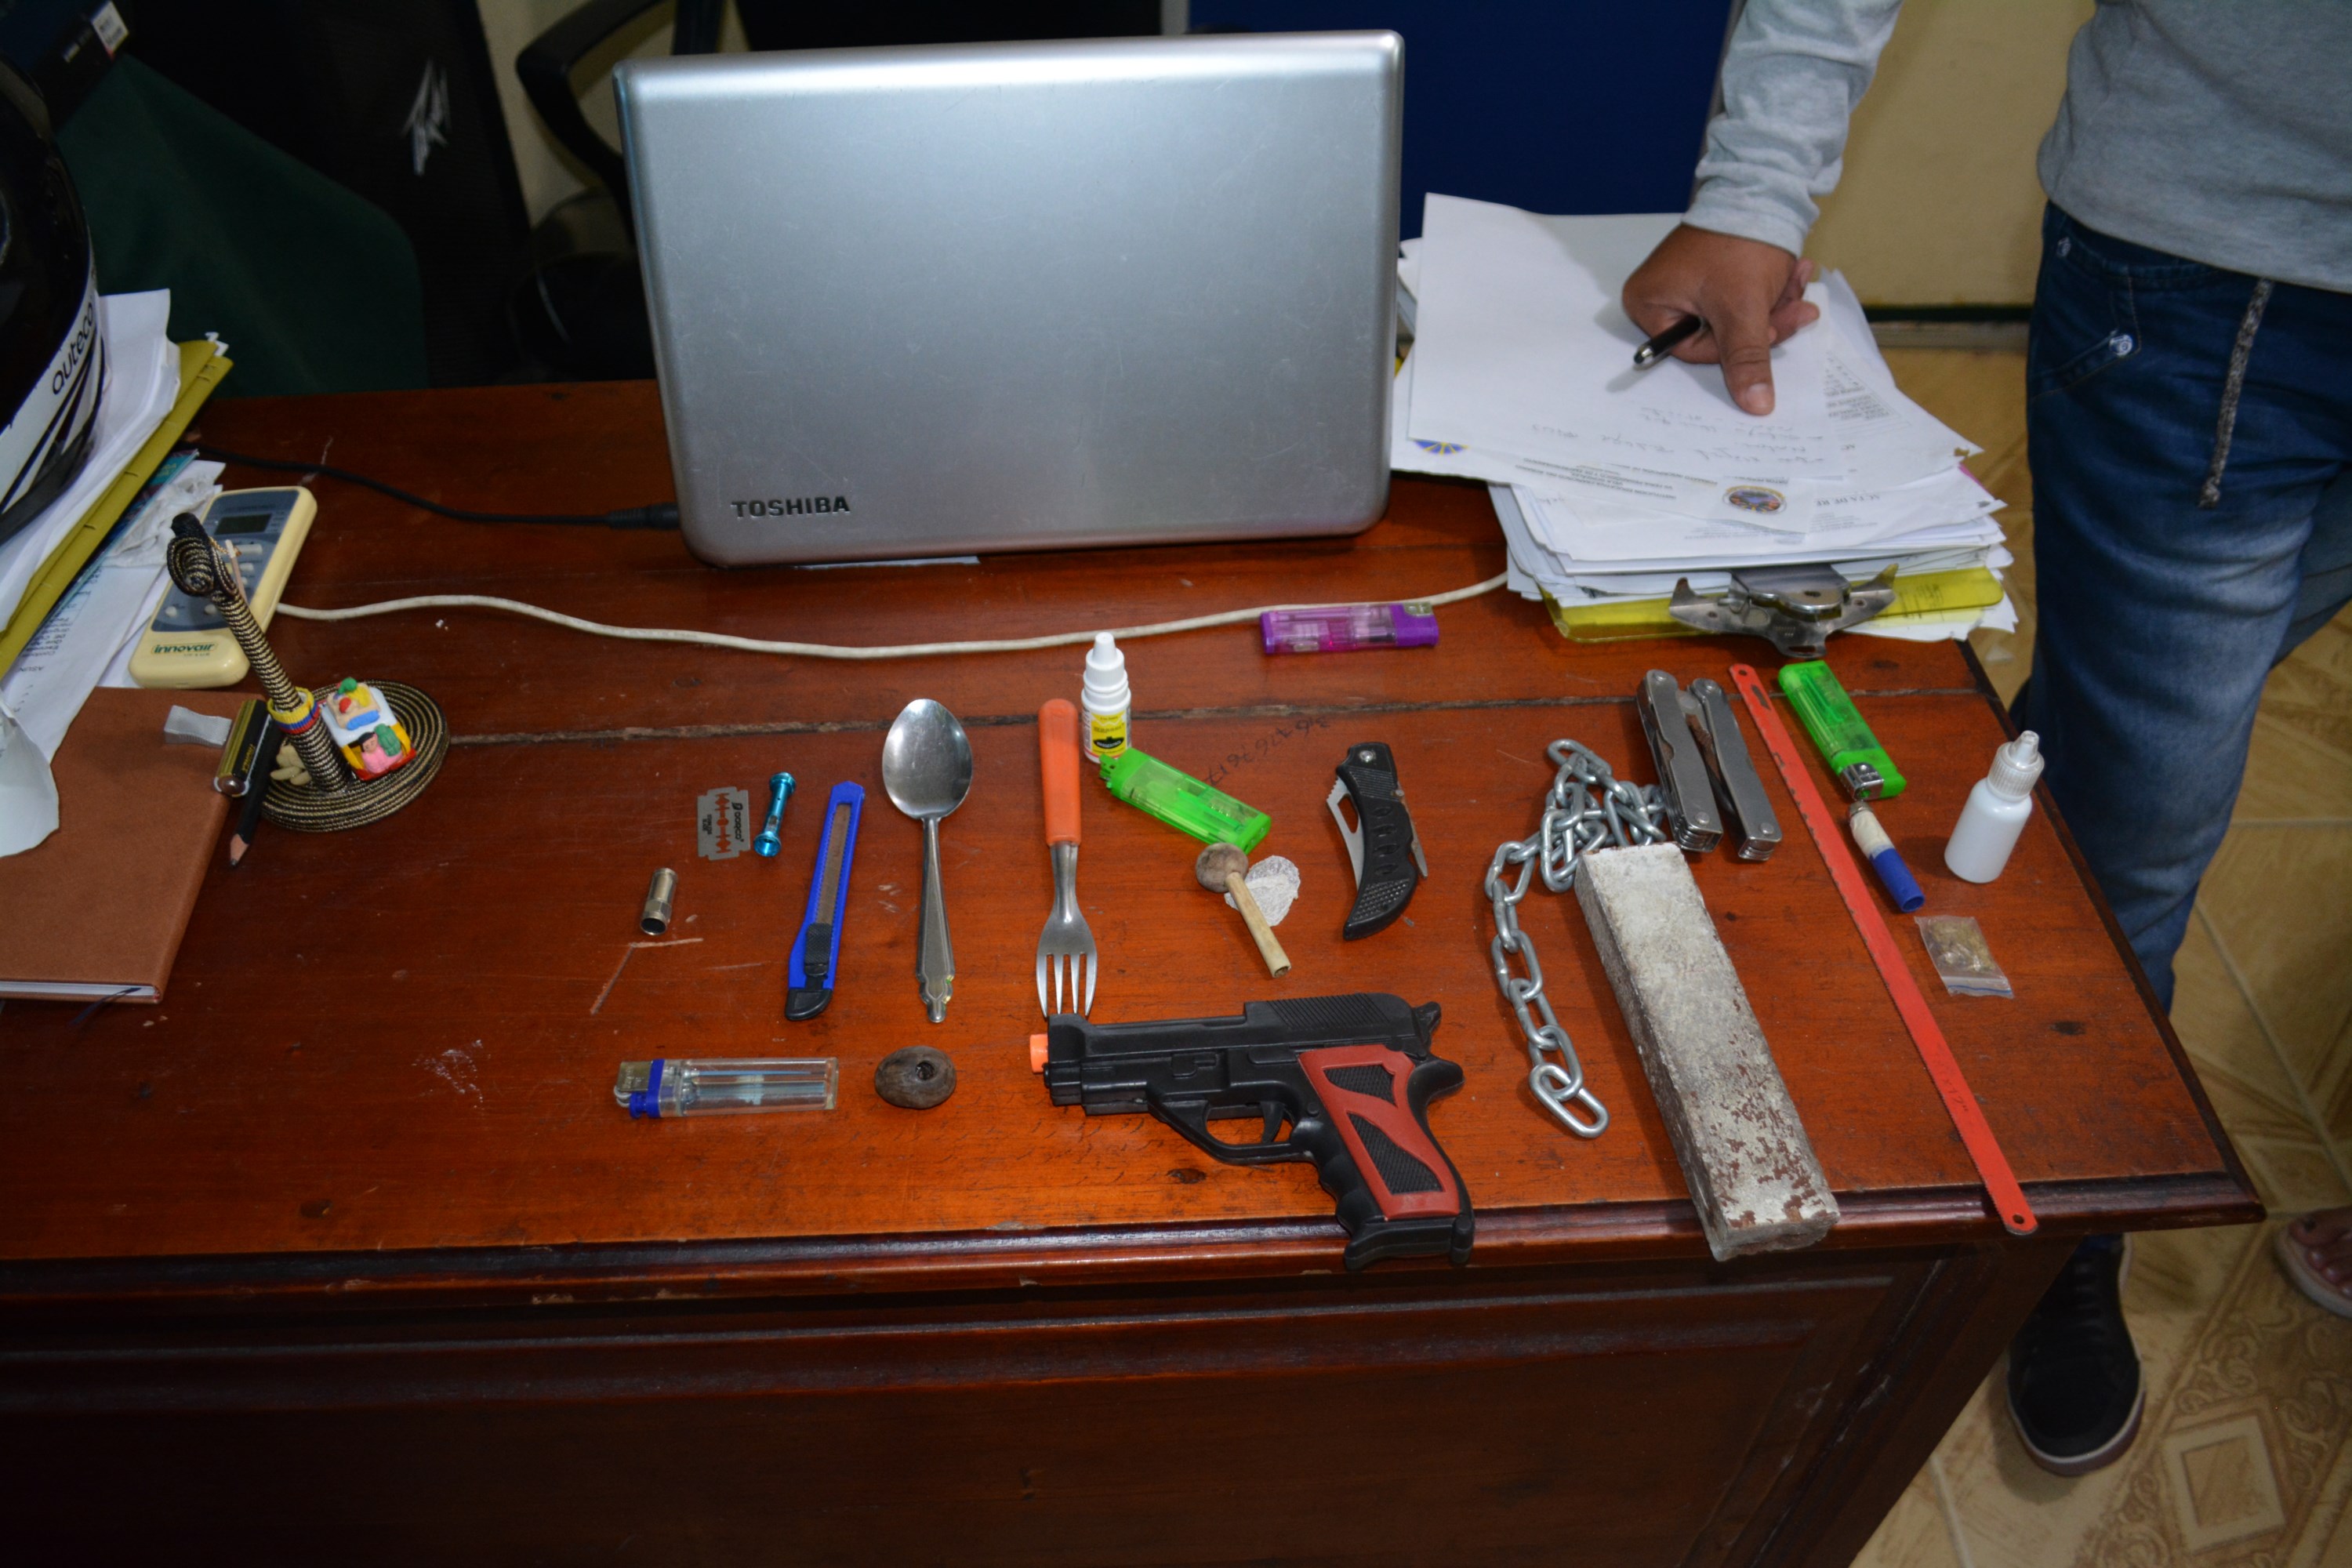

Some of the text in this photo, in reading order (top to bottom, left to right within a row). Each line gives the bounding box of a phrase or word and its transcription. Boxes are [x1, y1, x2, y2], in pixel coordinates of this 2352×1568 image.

[52, 303, 93, 395] auteco
[731, 495, 851, 517] TOSHIBA
[154, 642, 215, 655] innovair
